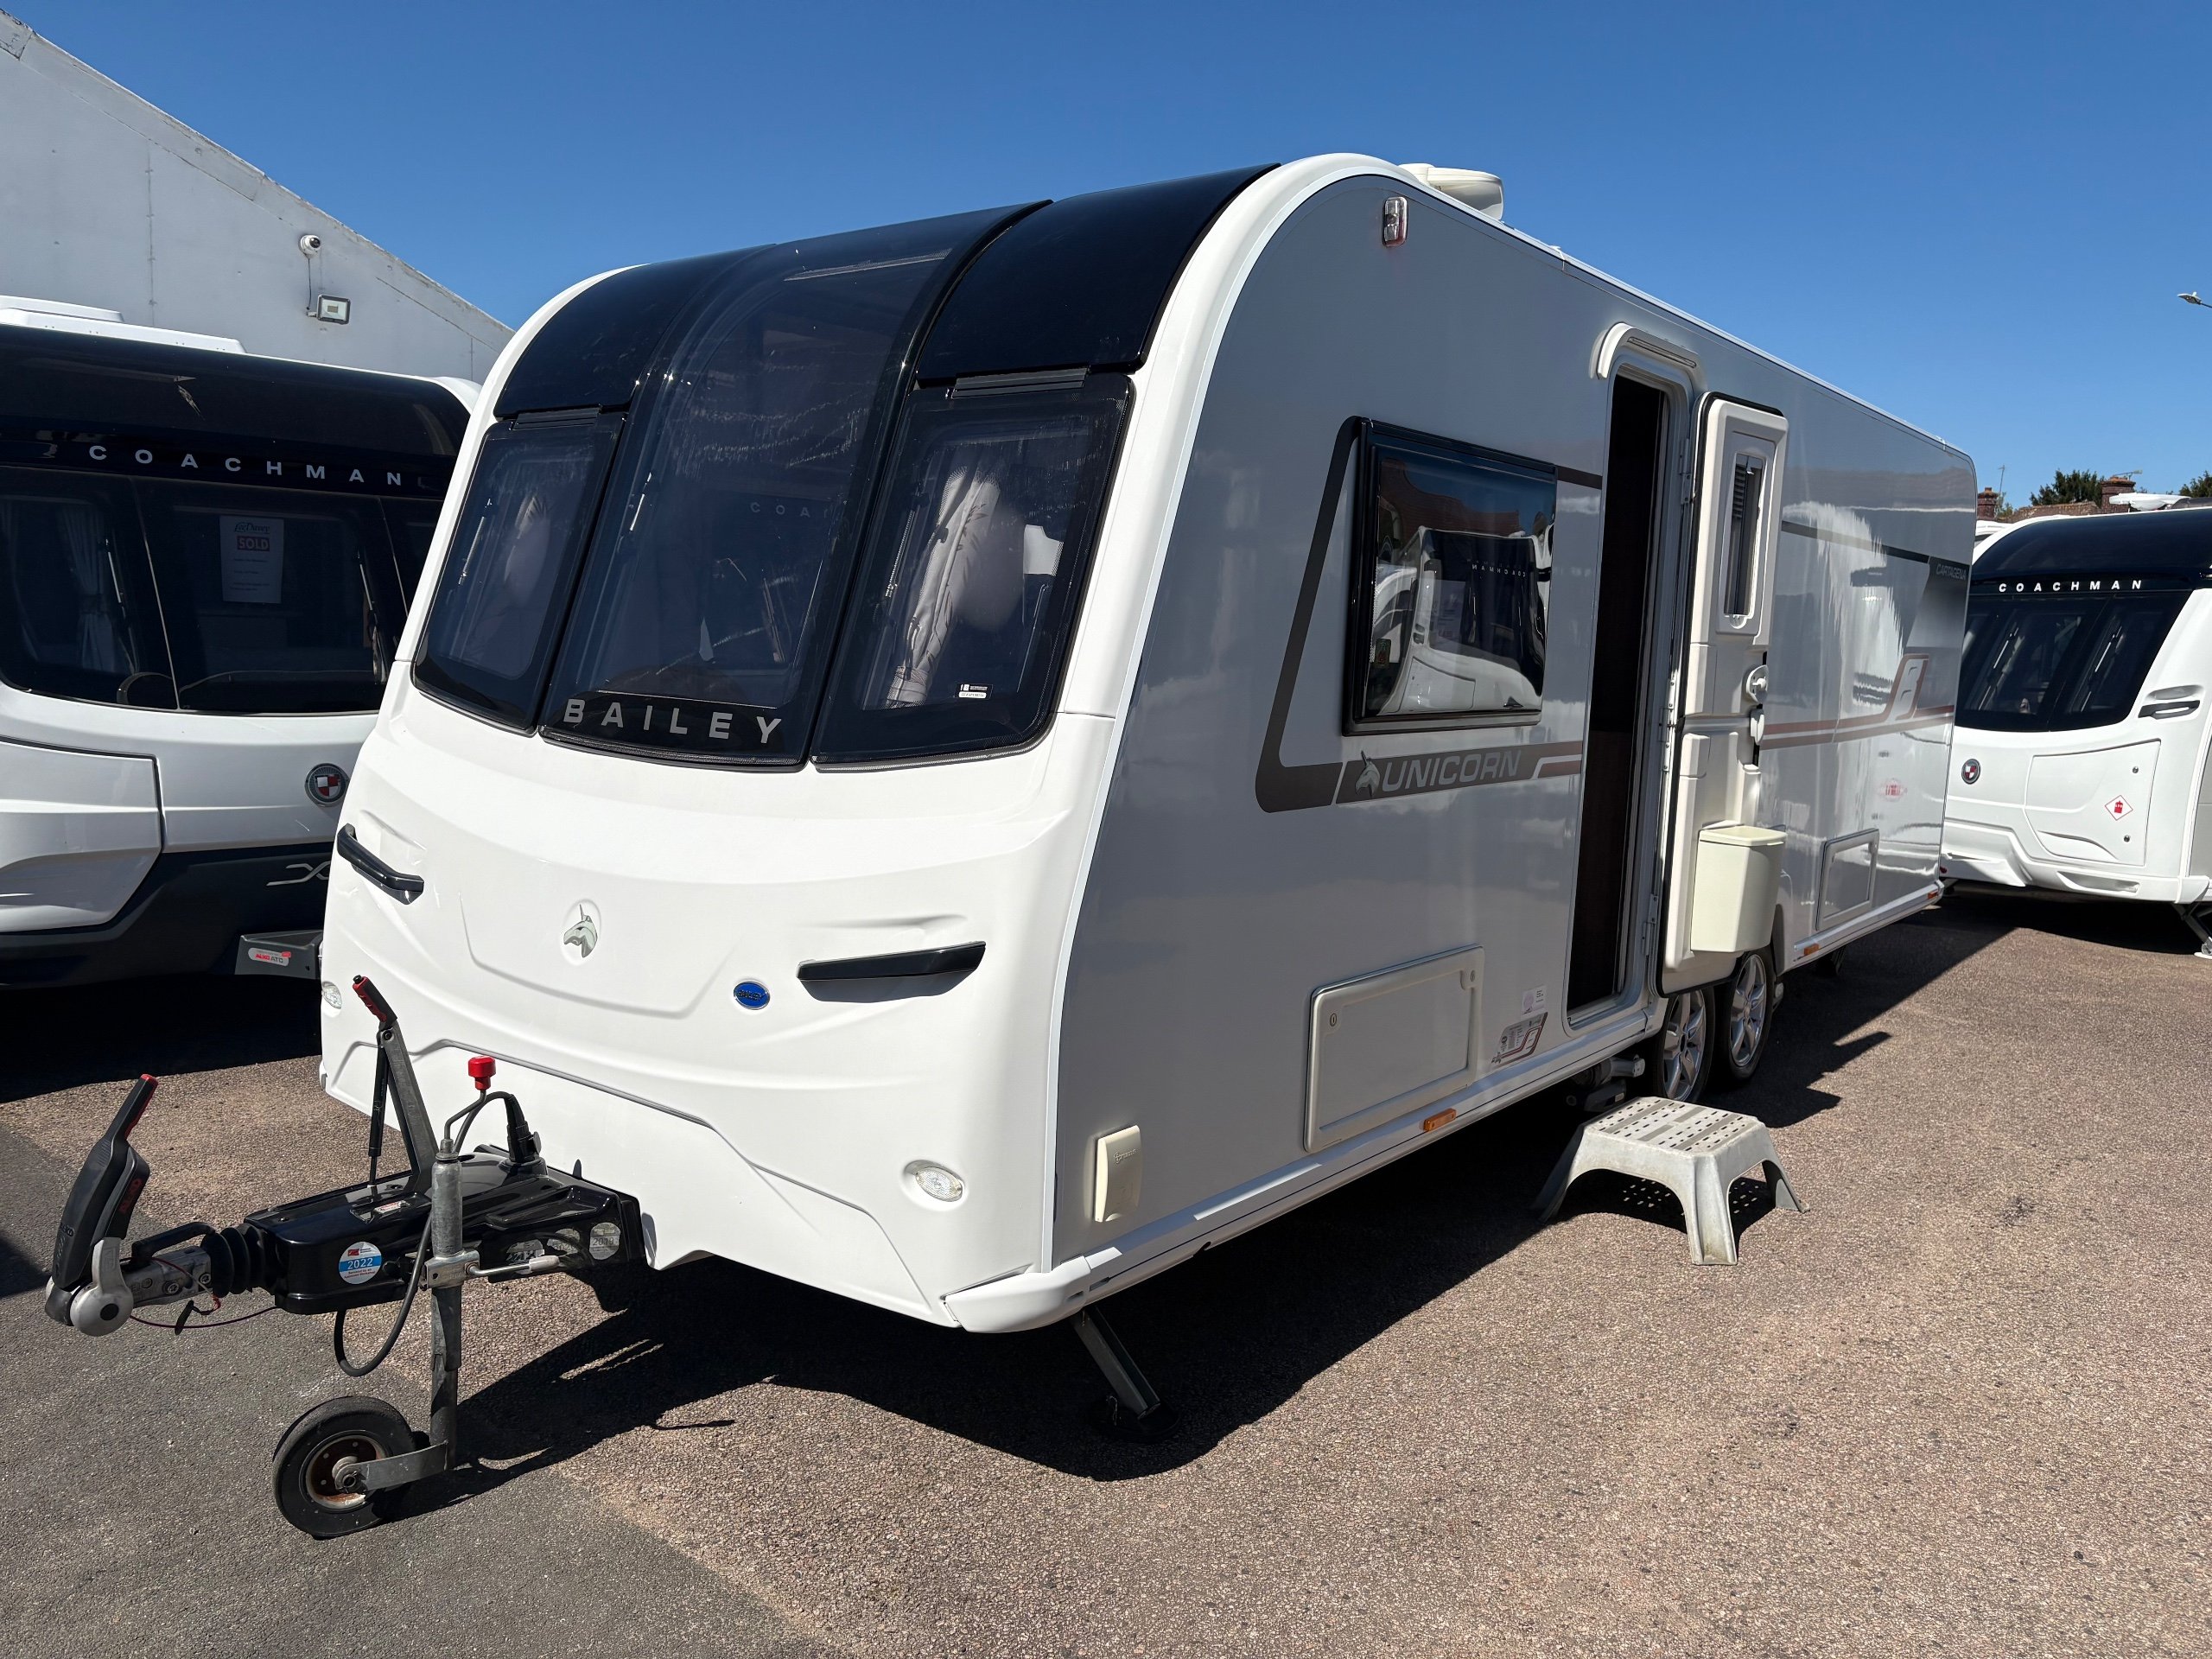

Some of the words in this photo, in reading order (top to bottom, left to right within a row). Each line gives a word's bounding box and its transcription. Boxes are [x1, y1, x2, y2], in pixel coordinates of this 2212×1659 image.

[88, 444, 402, 486] COACHMAN
[238, 537, 269, 550] SOLD
[1936, 563, 1967, 580] CARTAGENA
[1999, 580, 2142, 593] COACHMAN
[563, 698, 782, 744] BAILEY
[1382, 749, 1522, 792] UNICORN
[347, 1257, 373, 1270] 2022
